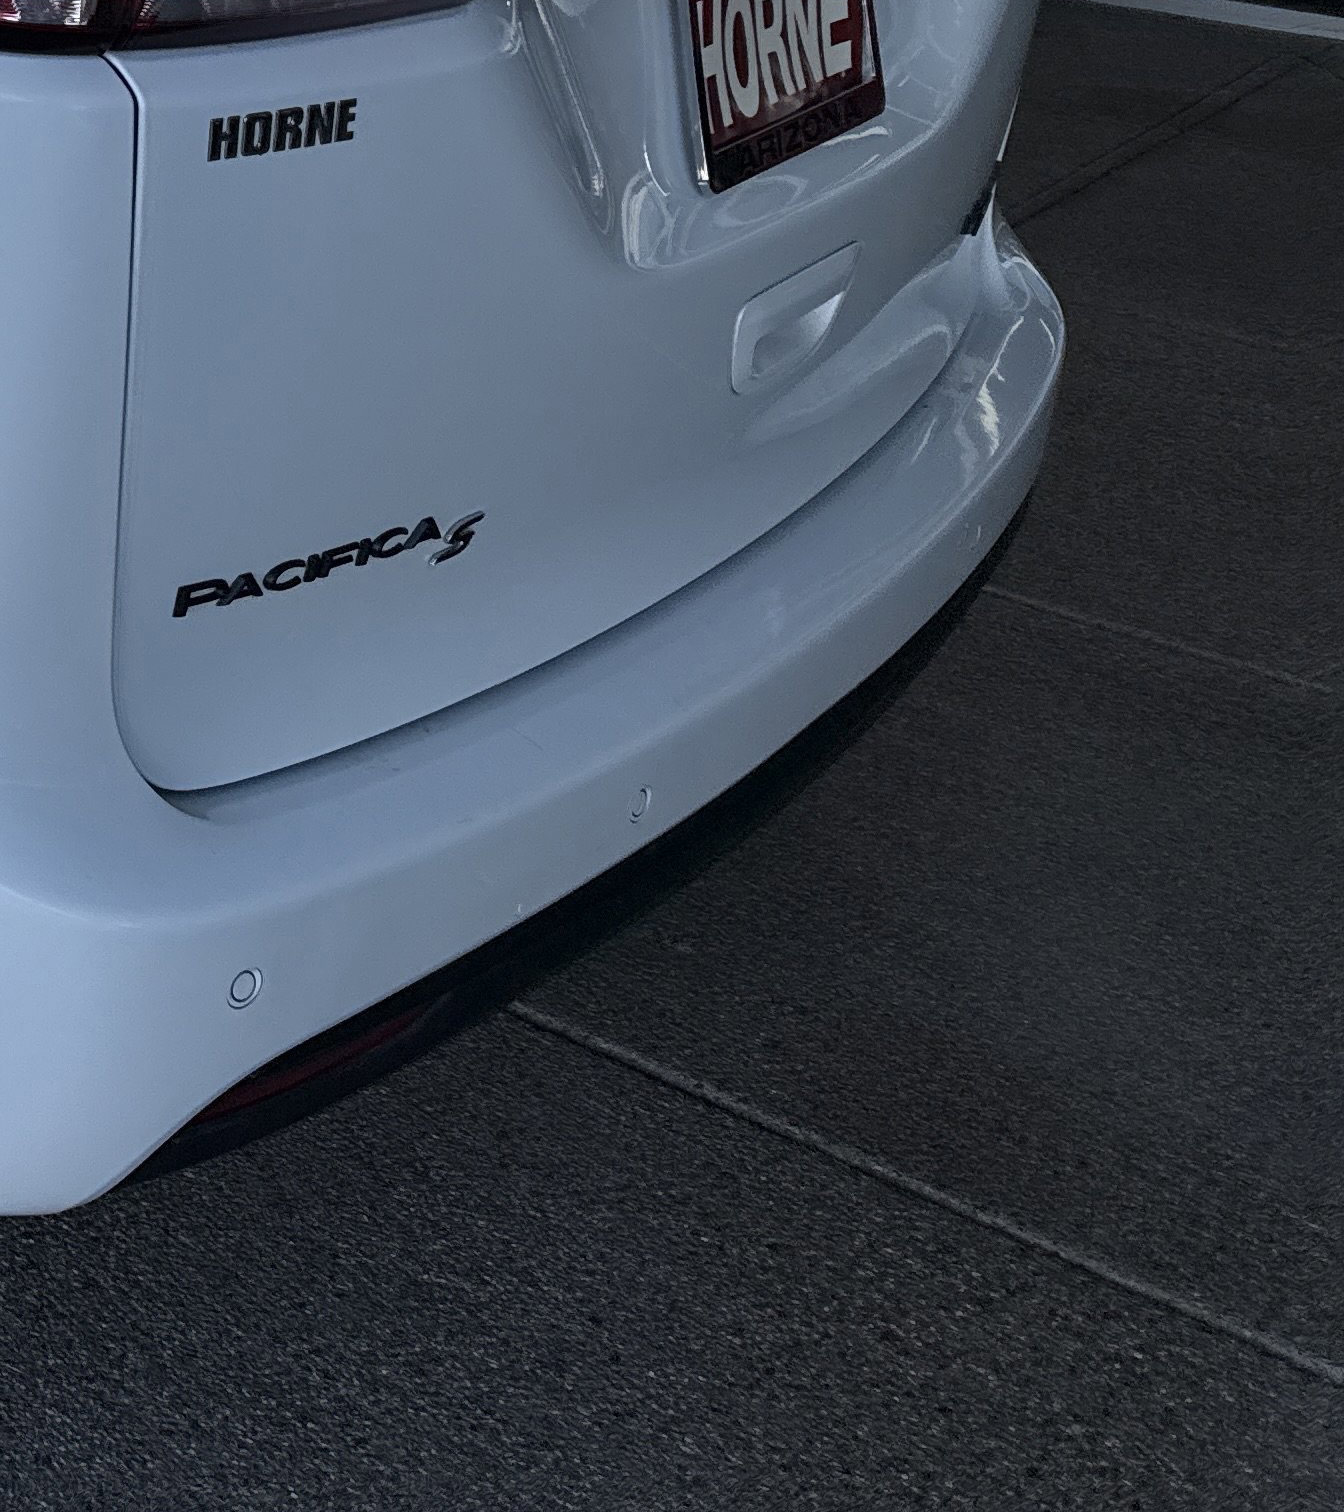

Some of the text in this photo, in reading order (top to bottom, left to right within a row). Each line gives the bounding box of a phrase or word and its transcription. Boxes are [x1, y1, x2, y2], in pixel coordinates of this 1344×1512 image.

[207, 97, 358, 163] HORNE
[171, 510, 486, 618] PACIFICA S
